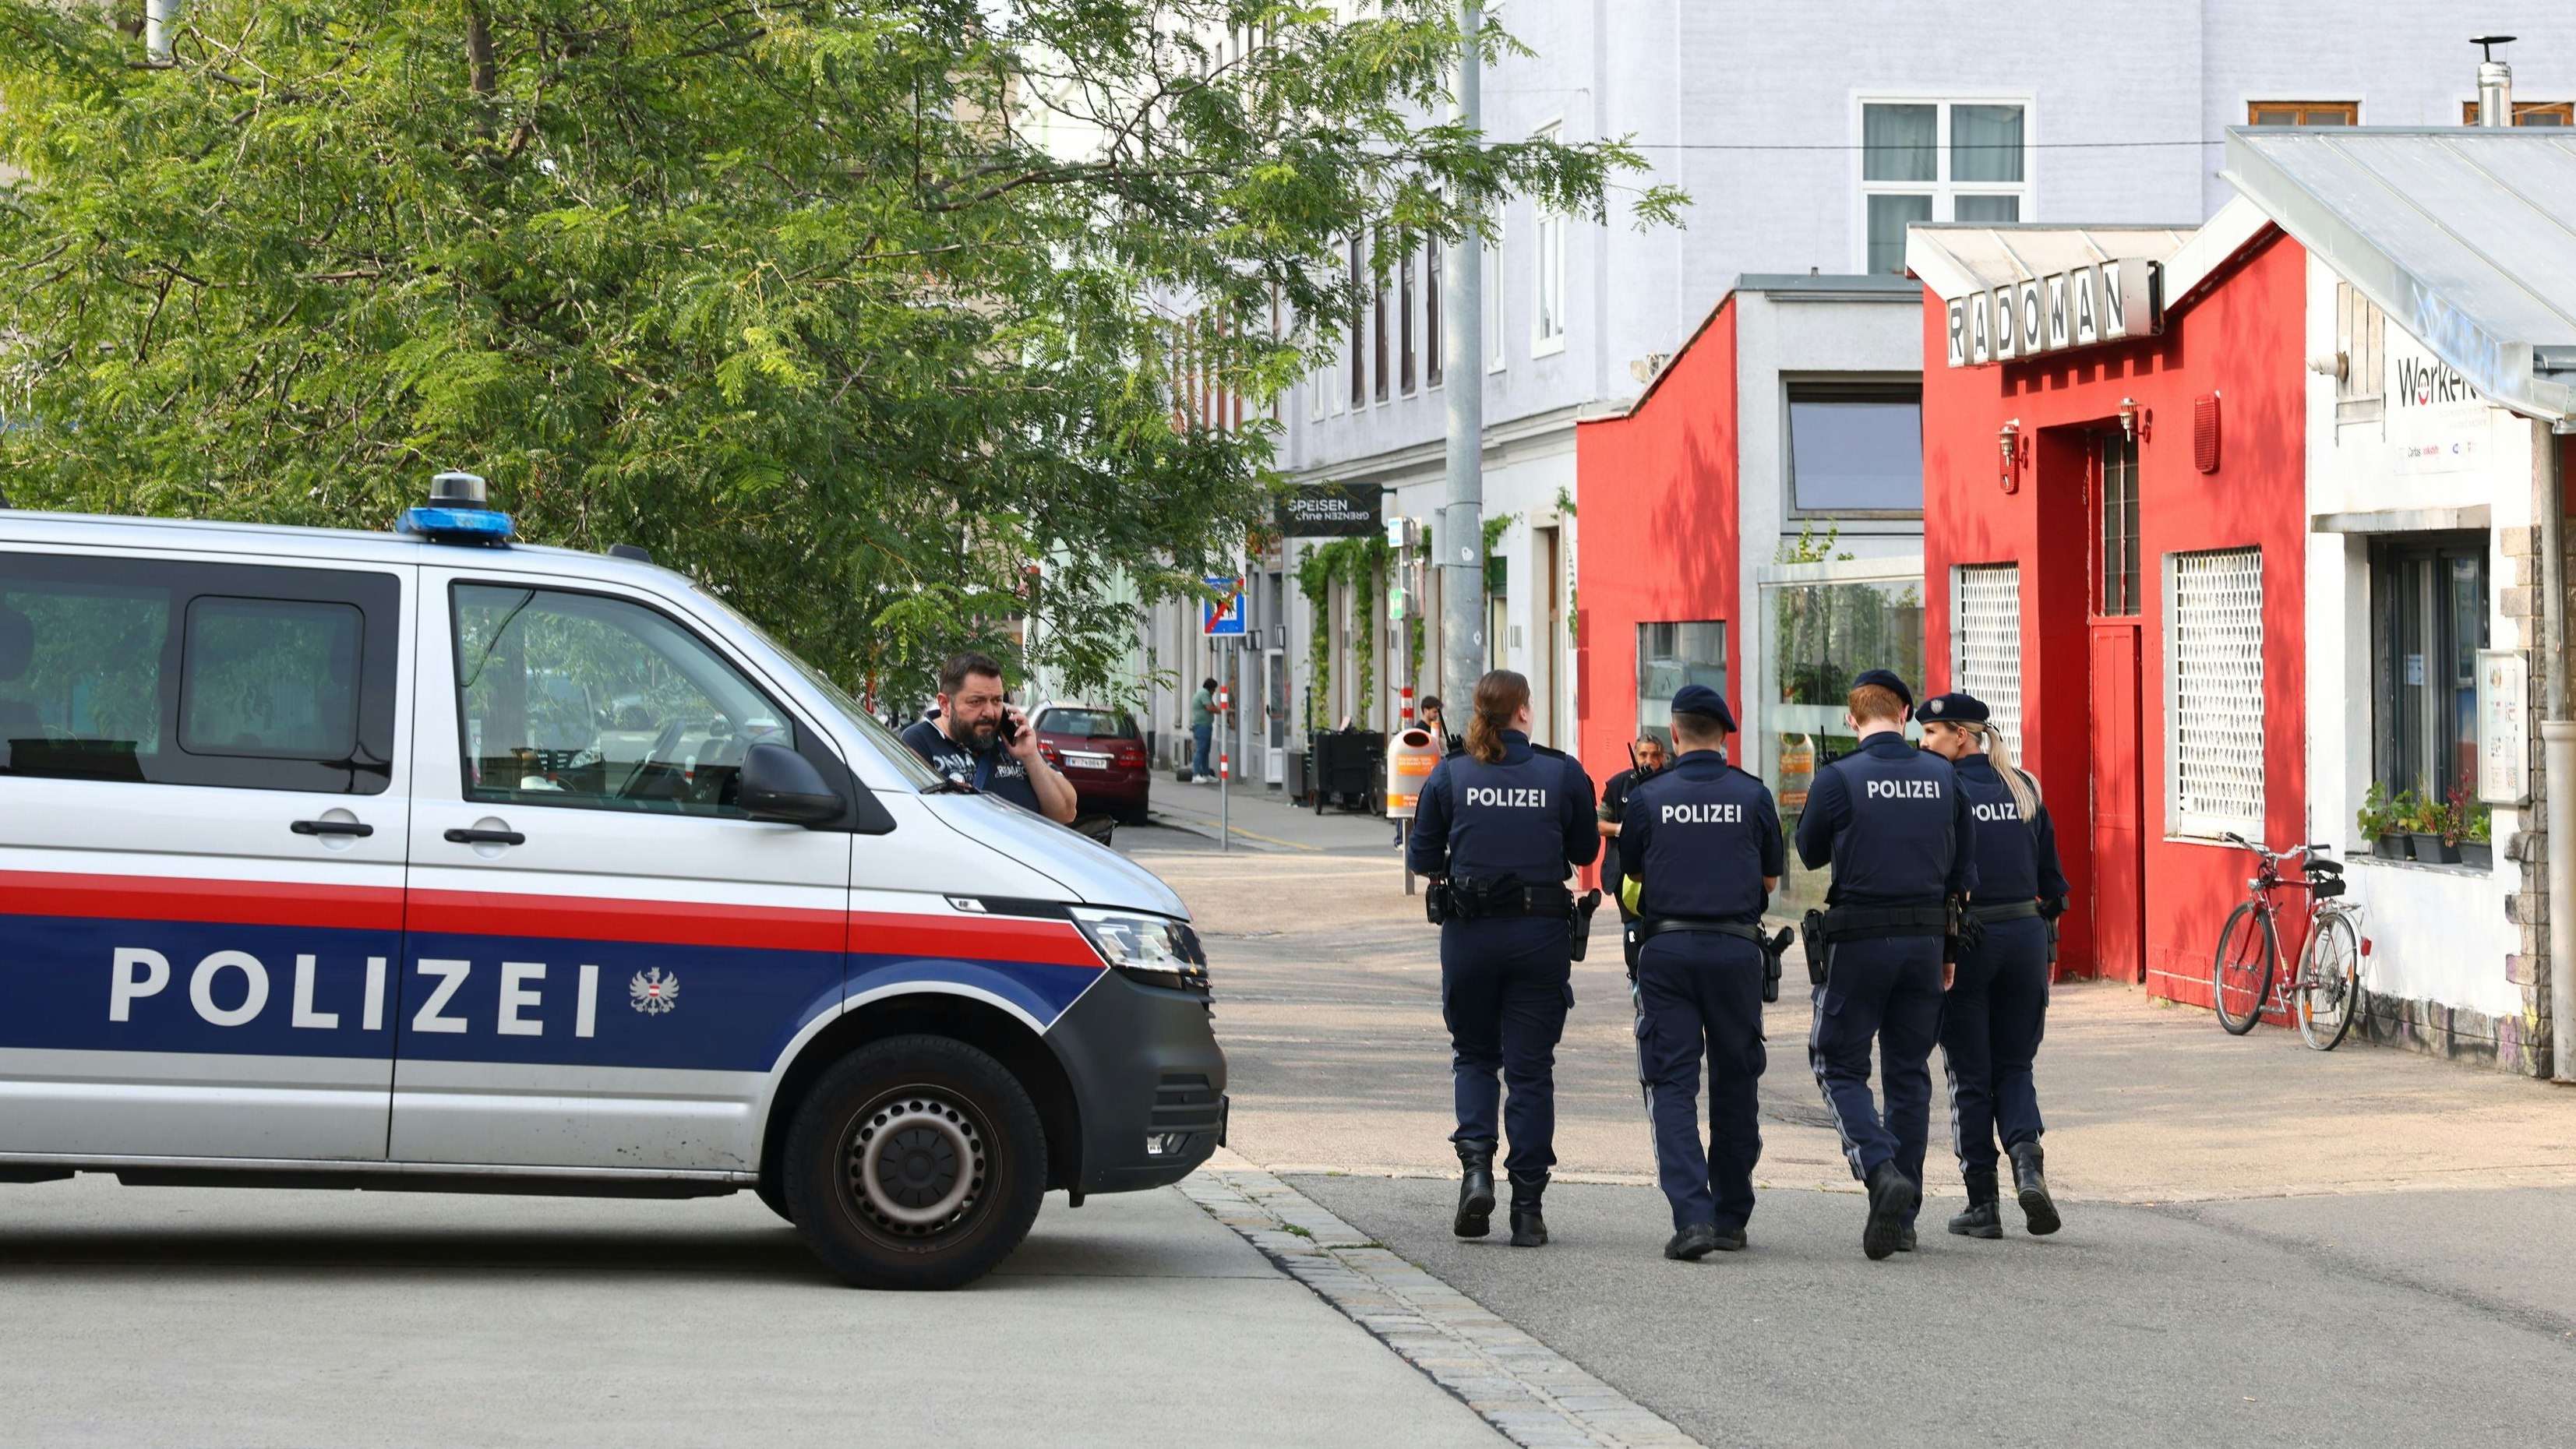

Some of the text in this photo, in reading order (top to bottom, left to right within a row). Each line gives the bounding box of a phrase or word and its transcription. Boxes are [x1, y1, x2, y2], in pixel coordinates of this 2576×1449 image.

[1950, 270, 2124, 359] RADOWAN
[2398, 356, 2477, 407] Worke
[1295, 511, 1370, 521] ohne GRENZEN
[1466, 788, 1546, 808] POLIZEI
[1868, 780, 1941, 799] POLIZEI
[1662, 805, 1741, 824] POLIZEI
[110, 947, 599, 1038] POLIZEI
